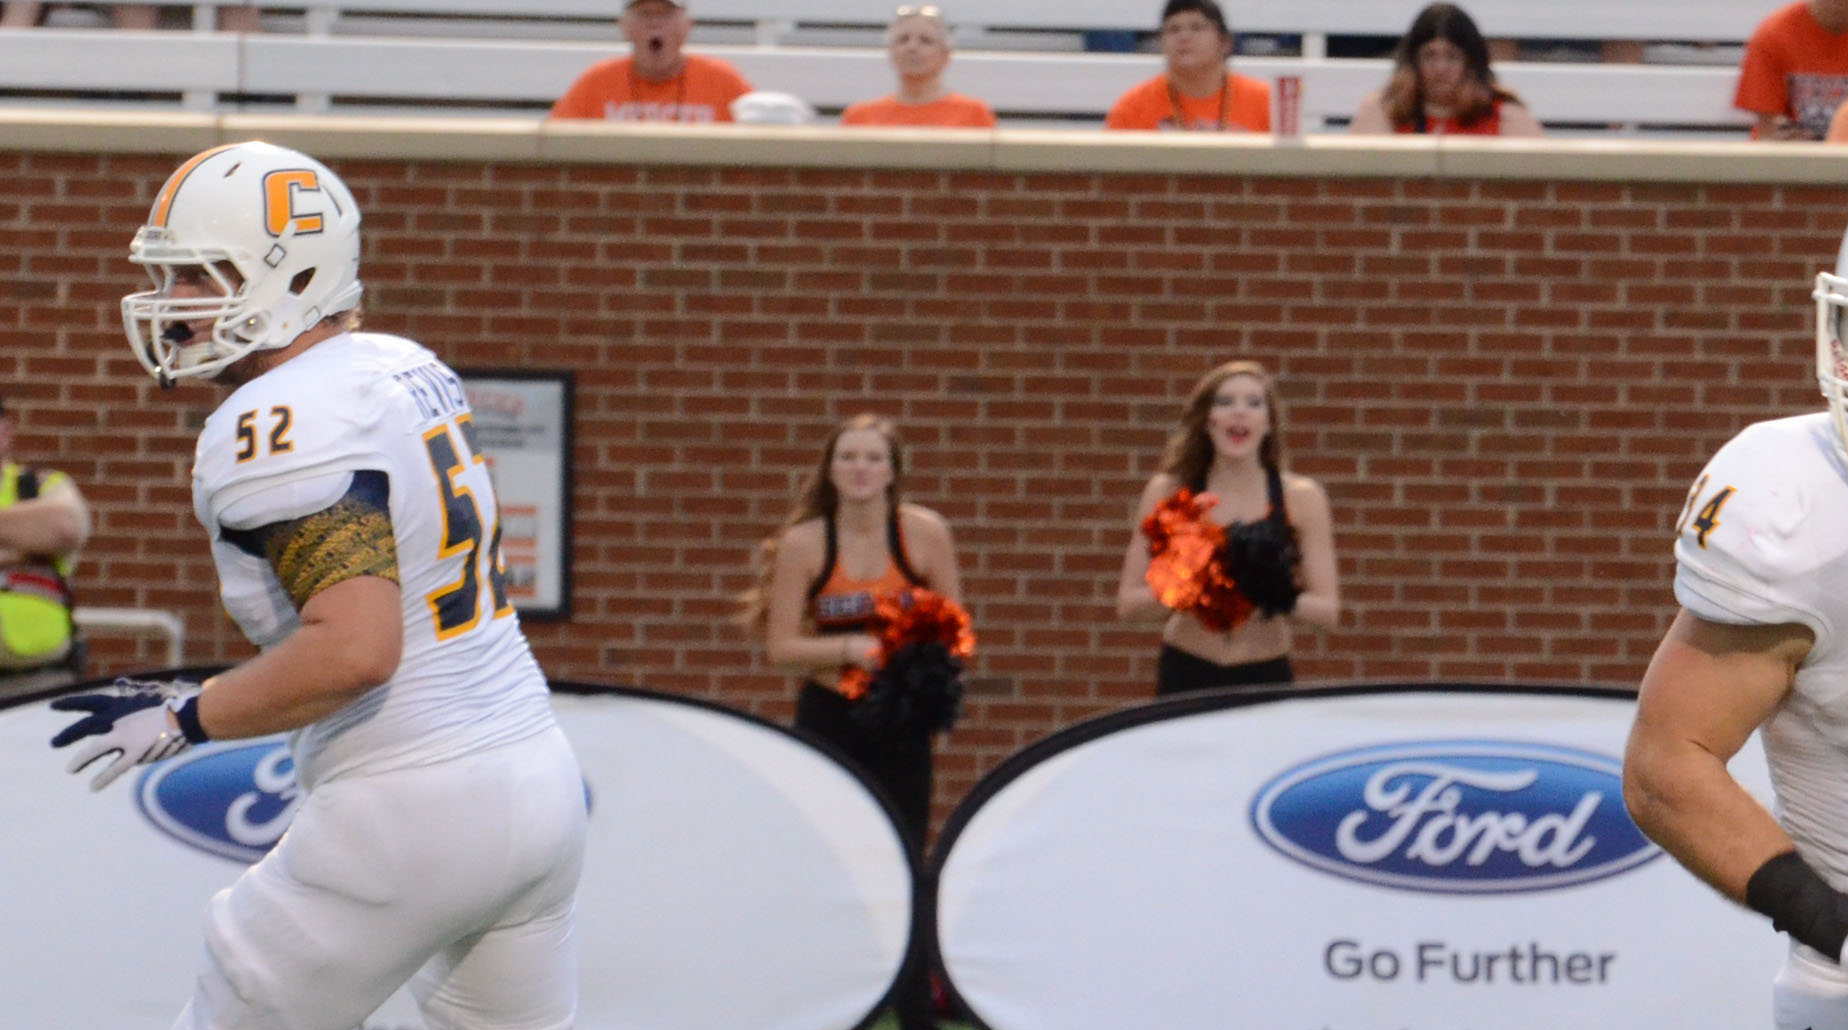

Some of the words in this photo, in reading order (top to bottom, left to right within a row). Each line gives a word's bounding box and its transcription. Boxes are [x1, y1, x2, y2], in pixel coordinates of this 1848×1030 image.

[262, 168, 323, 238] C
[235, 405, 295, 465] 52
[1336, 762, 1604, 868] Ford
[1324, 939, 1401, 981] Go
[1416, 942, 1616, 985] Further
